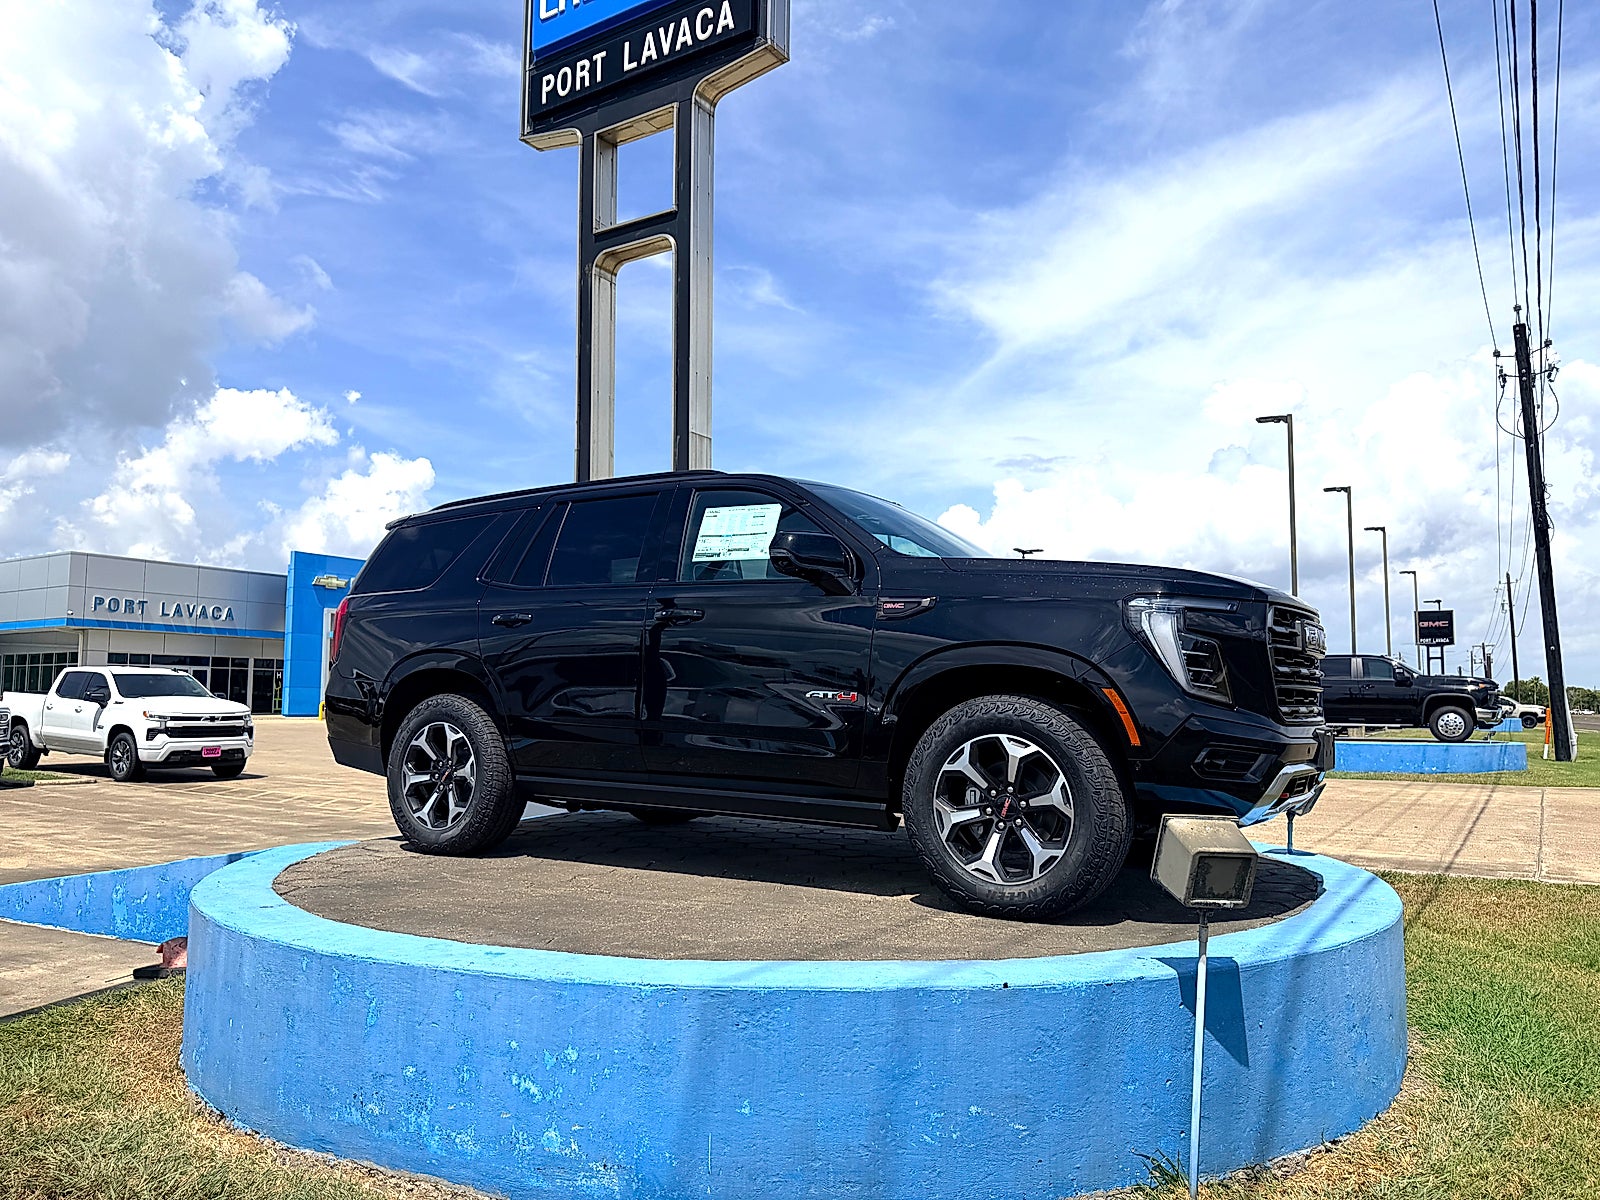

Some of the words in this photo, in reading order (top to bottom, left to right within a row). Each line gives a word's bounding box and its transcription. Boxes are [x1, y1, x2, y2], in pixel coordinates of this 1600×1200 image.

[541, 51, 607, 104] PORT
[623, 1, 735, 72] LAVACA
[92, 596, 149, 615] PORT
[159, 602, 235, 621] LAVACA
[805, 690, 858, 703] AT4
